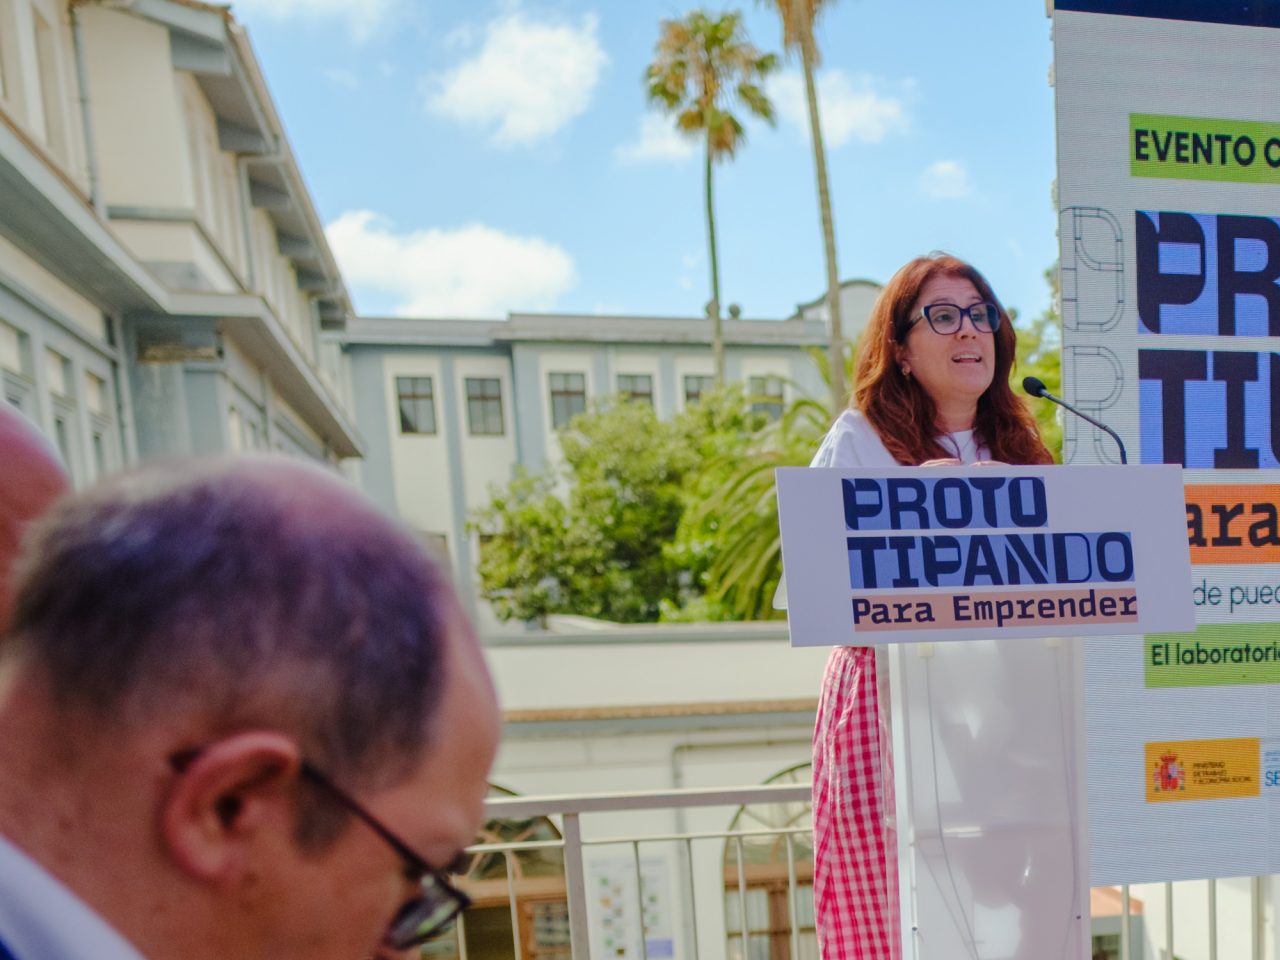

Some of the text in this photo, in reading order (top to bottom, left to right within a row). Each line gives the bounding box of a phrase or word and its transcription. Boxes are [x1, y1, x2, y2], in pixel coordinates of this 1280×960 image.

[1135, 129, 1256, 167] EVENTO
[842, 476, 1048, 530] PROTO
[847, 531, 1134, 589] TIPANDO
[852, 589, 1138, 628] Para Emprender
[1193, 578, 1222, 606] de
[1151, 643, 1169, 666] El
